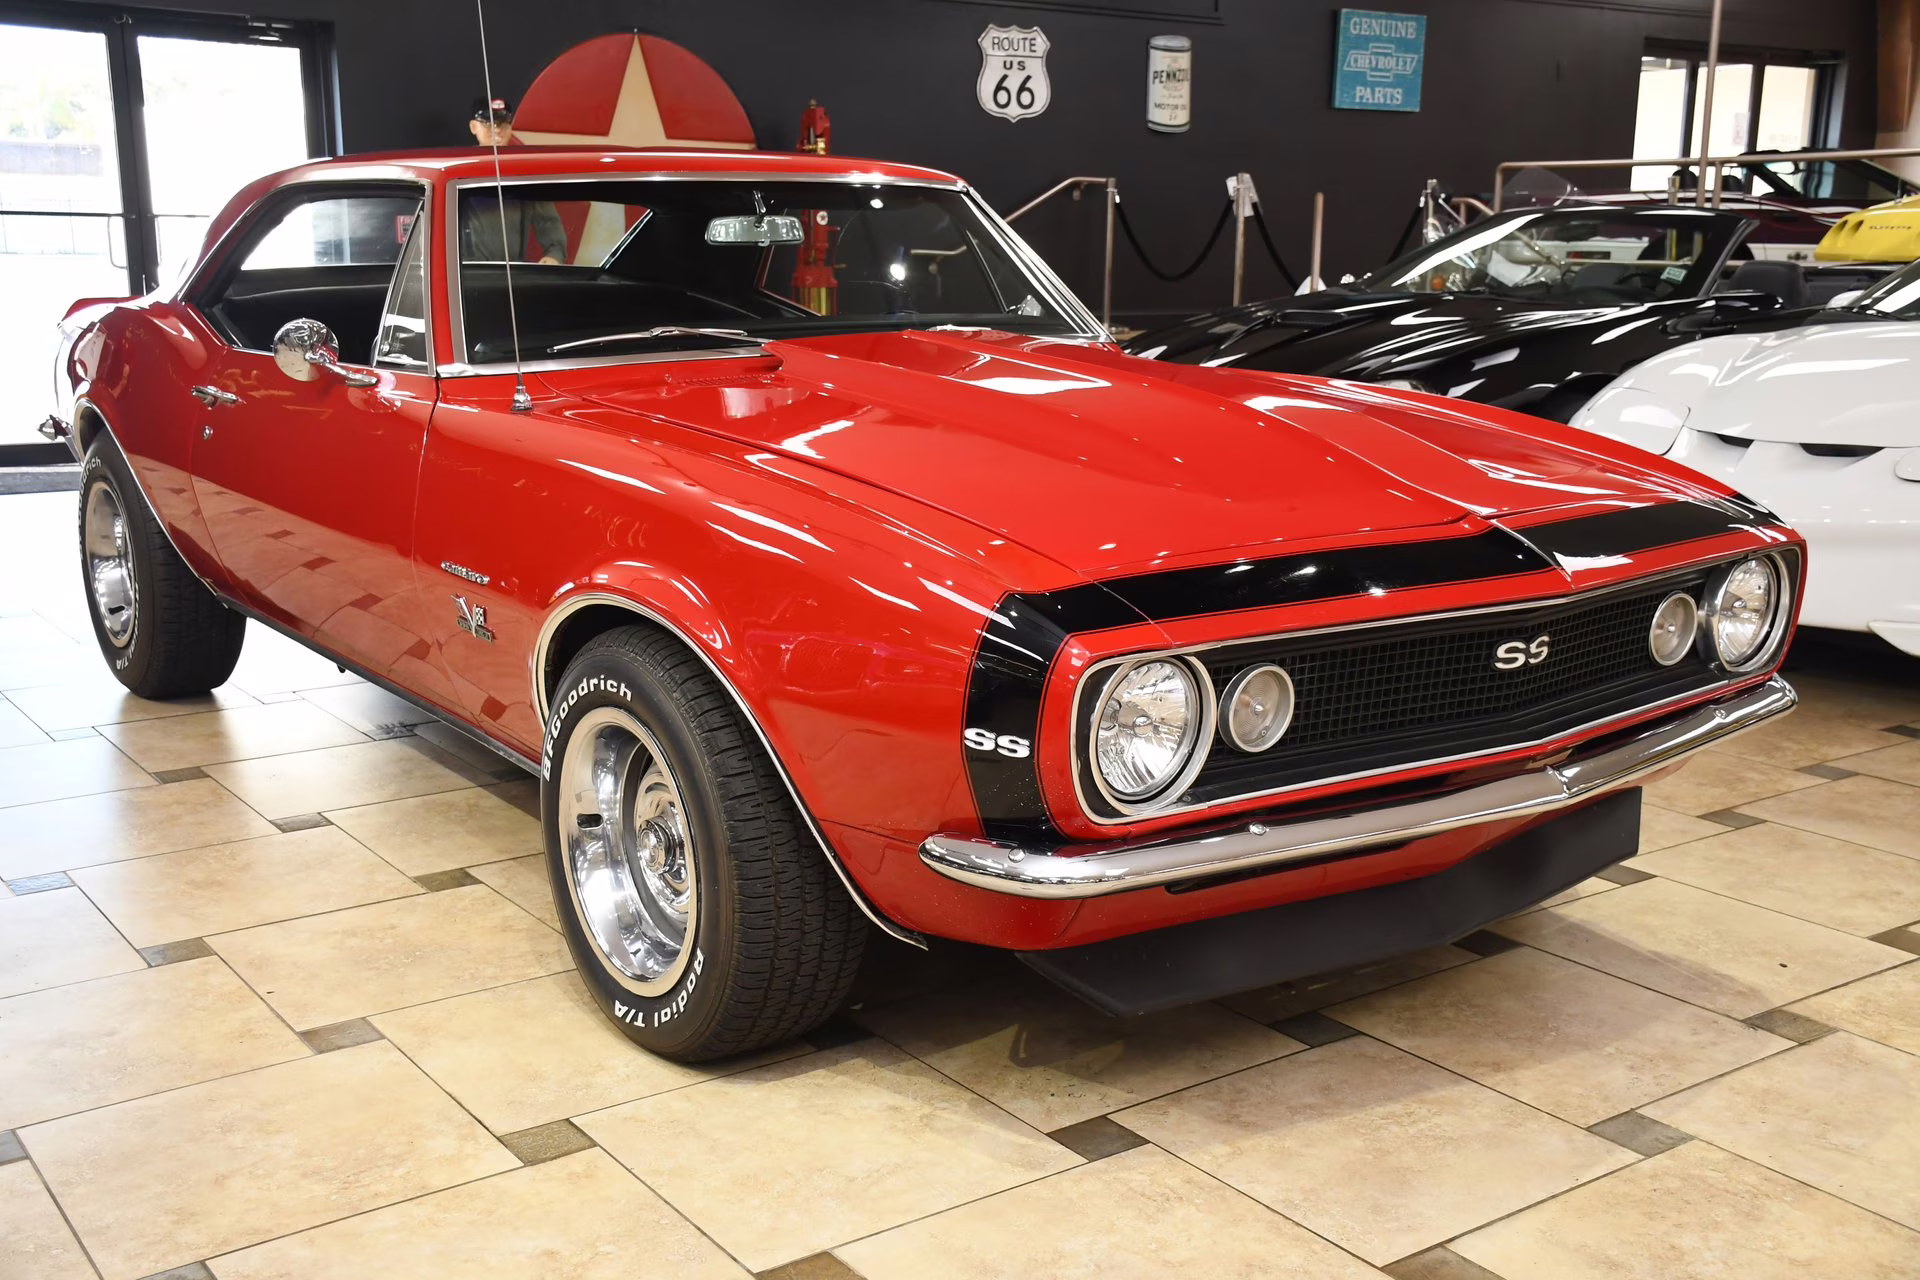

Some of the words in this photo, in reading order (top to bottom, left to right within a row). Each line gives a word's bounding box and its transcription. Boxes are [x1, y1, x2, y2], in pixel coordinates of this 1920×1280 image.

[1350, 17, 1417, 39] GENUINE
[991, 36, 1037, 52] ROUTE
[1003, 60, 1026, 71] US
[1350, 54, 1412, 71] CHEVROLET
[993, 73, 1035, 110] 66
[1355, 86, 1402, 105] PARTS
[1494, 635, 1550, 670] SS
[542, 674, 632, 782] BFGoodrich
[963, 727, 1031, 759] SS
[653, 947, 704, 1028] Radial
[614, 999, 646, 1028] T/A
